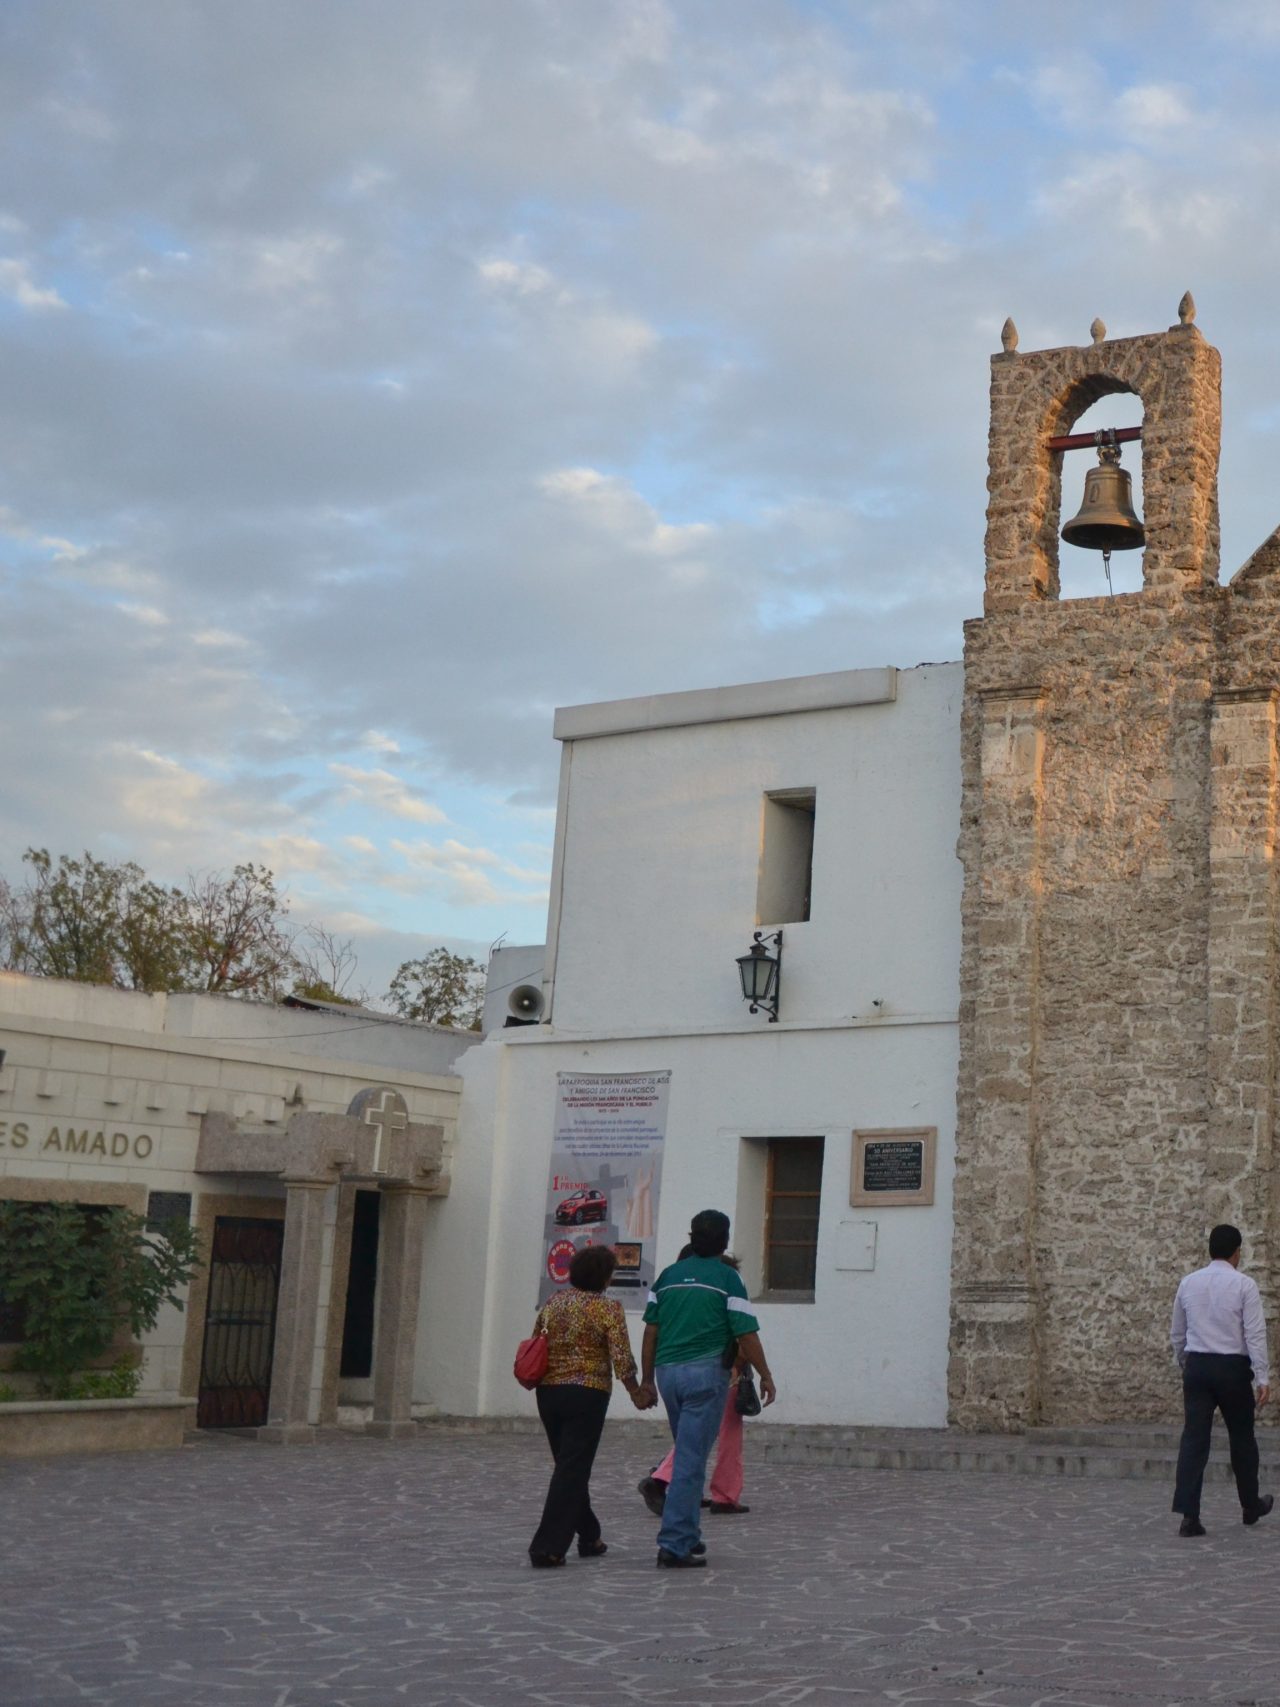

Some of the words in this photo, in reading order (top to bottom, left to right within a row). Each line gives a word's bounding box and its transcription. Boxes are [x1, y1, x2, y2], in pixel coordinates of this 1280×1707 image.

[614, 1077, 647, 1085] FRANCISCO
[621, 1086, 656, 1094] FRANCISCO
[43, 1126, 153, 1159] AMADO
